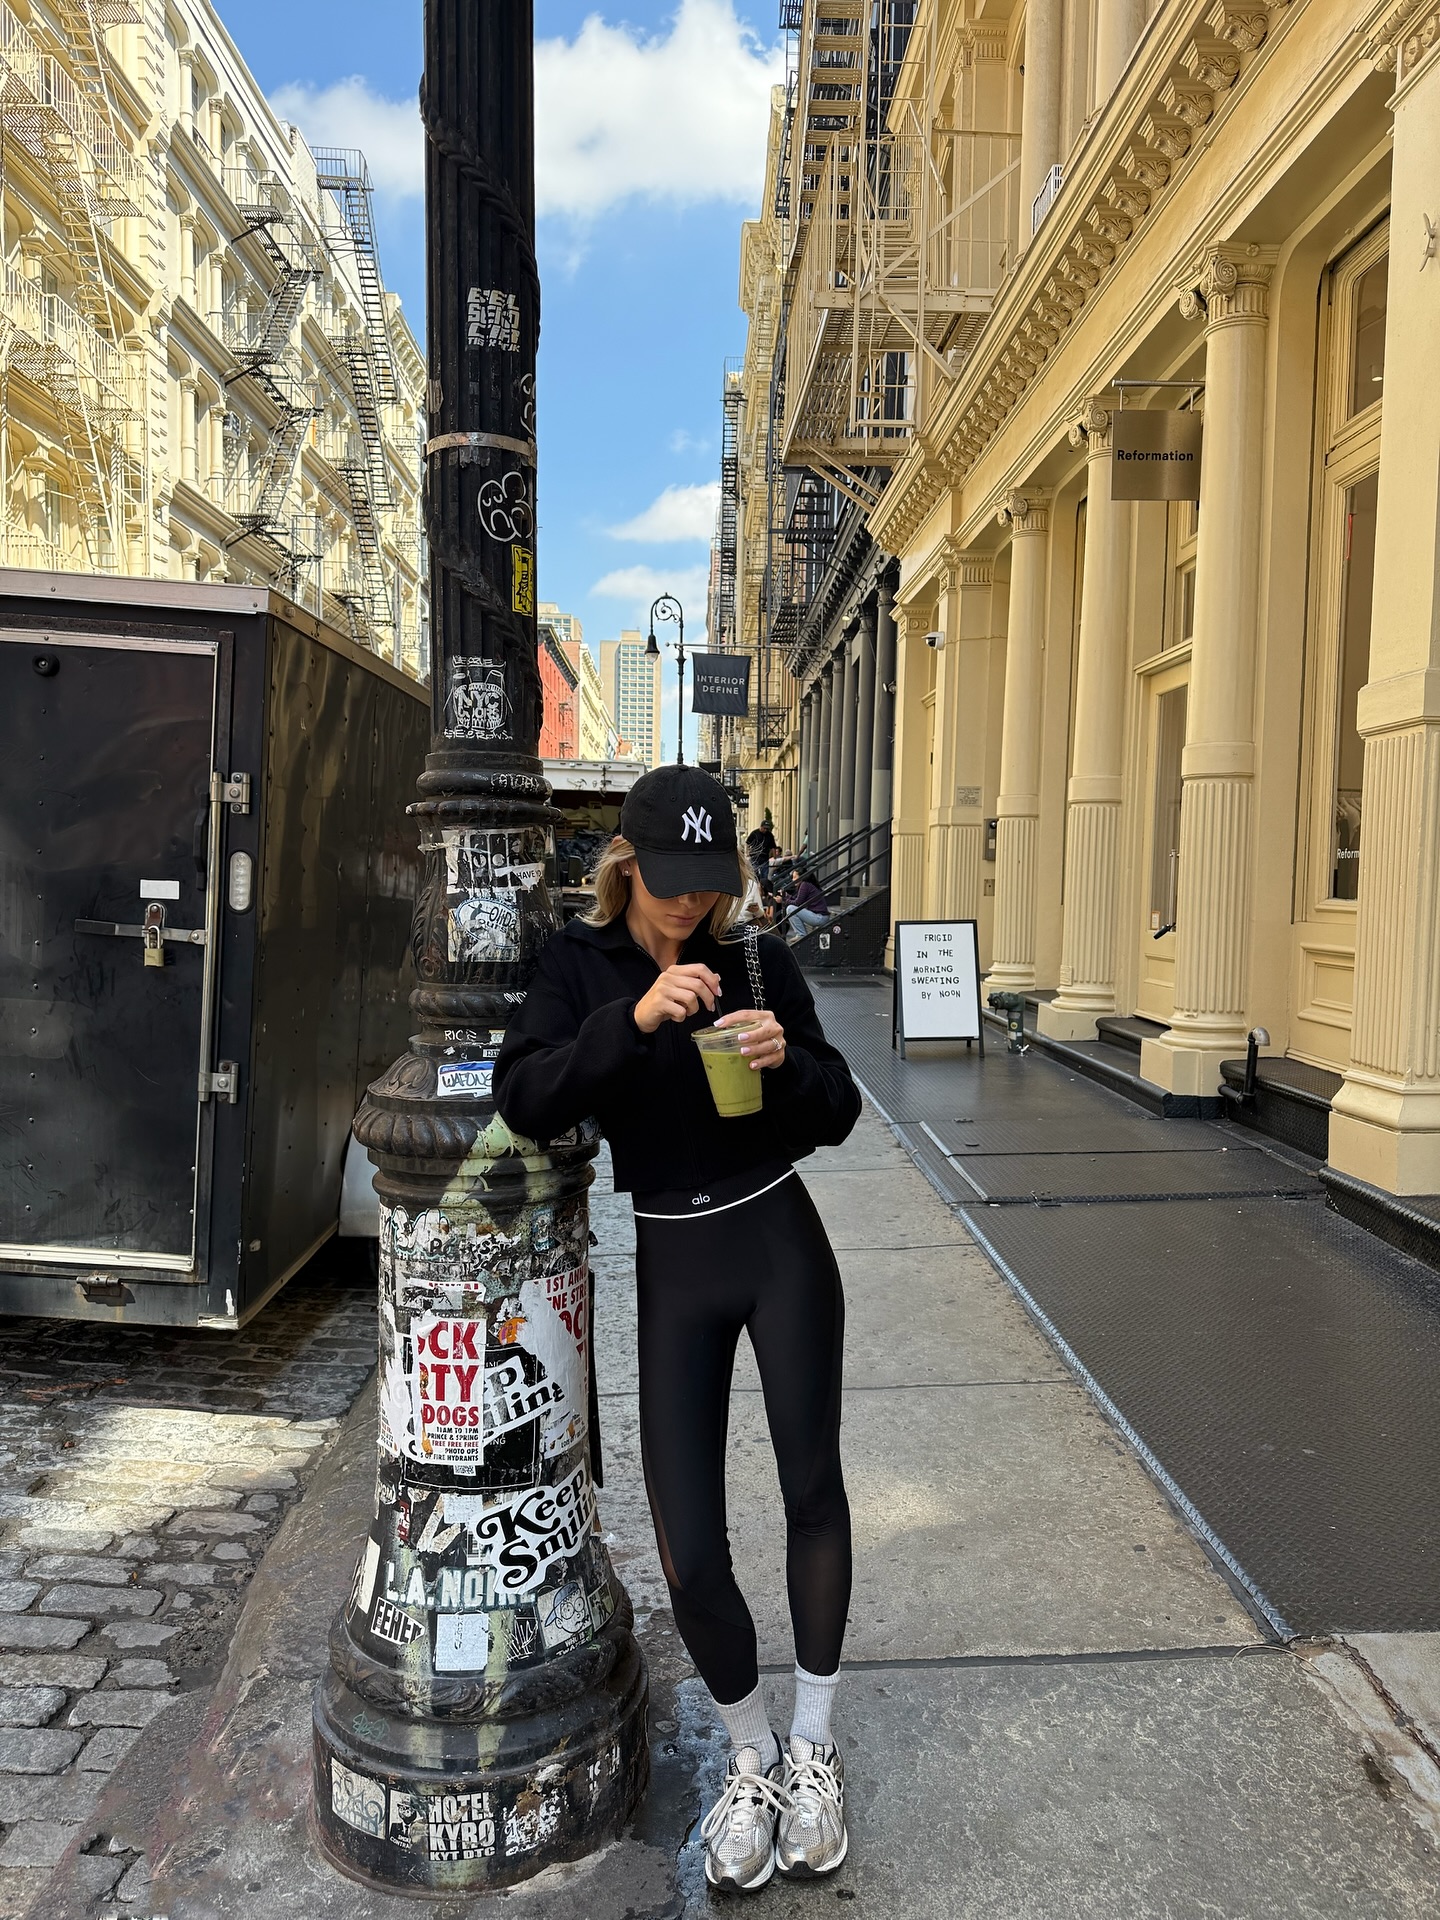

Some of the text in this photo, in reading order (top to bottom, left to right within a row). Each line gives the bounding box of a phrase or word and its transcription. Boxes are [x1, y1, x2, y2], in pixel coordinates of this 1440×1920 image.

[1117, 449, 1194, 461] Reformation
[696, 674, 745, 685] INTERIOR
[702, 685, 739, 695] DEFINE
[680, 805, 713, 844] NY
[924, 933, 953, 942] FRIGID
[916, 949, 953, 959] IN THE
[912, 965, 954, 974] MORNING
[911, 976, 960, 985] SWEATING
[921, 990, 961, 1000] BY NOON
[691, 1192, 711, 1205] alo
[421, 1403, 480, 1427] DOGS
[436, 1426, 453, 1434] 11AM
[427, 1432, 448, 1440] PRINCE
[447, 1440, 462, 1448] FREE
[476, 1469, 584, 1546] Keep
[428, 1792, 494, 1823] HOTEL
[429, 1819, 496, 1851] KYRO
[429, 1846, 496, 1861] KYT DTC
